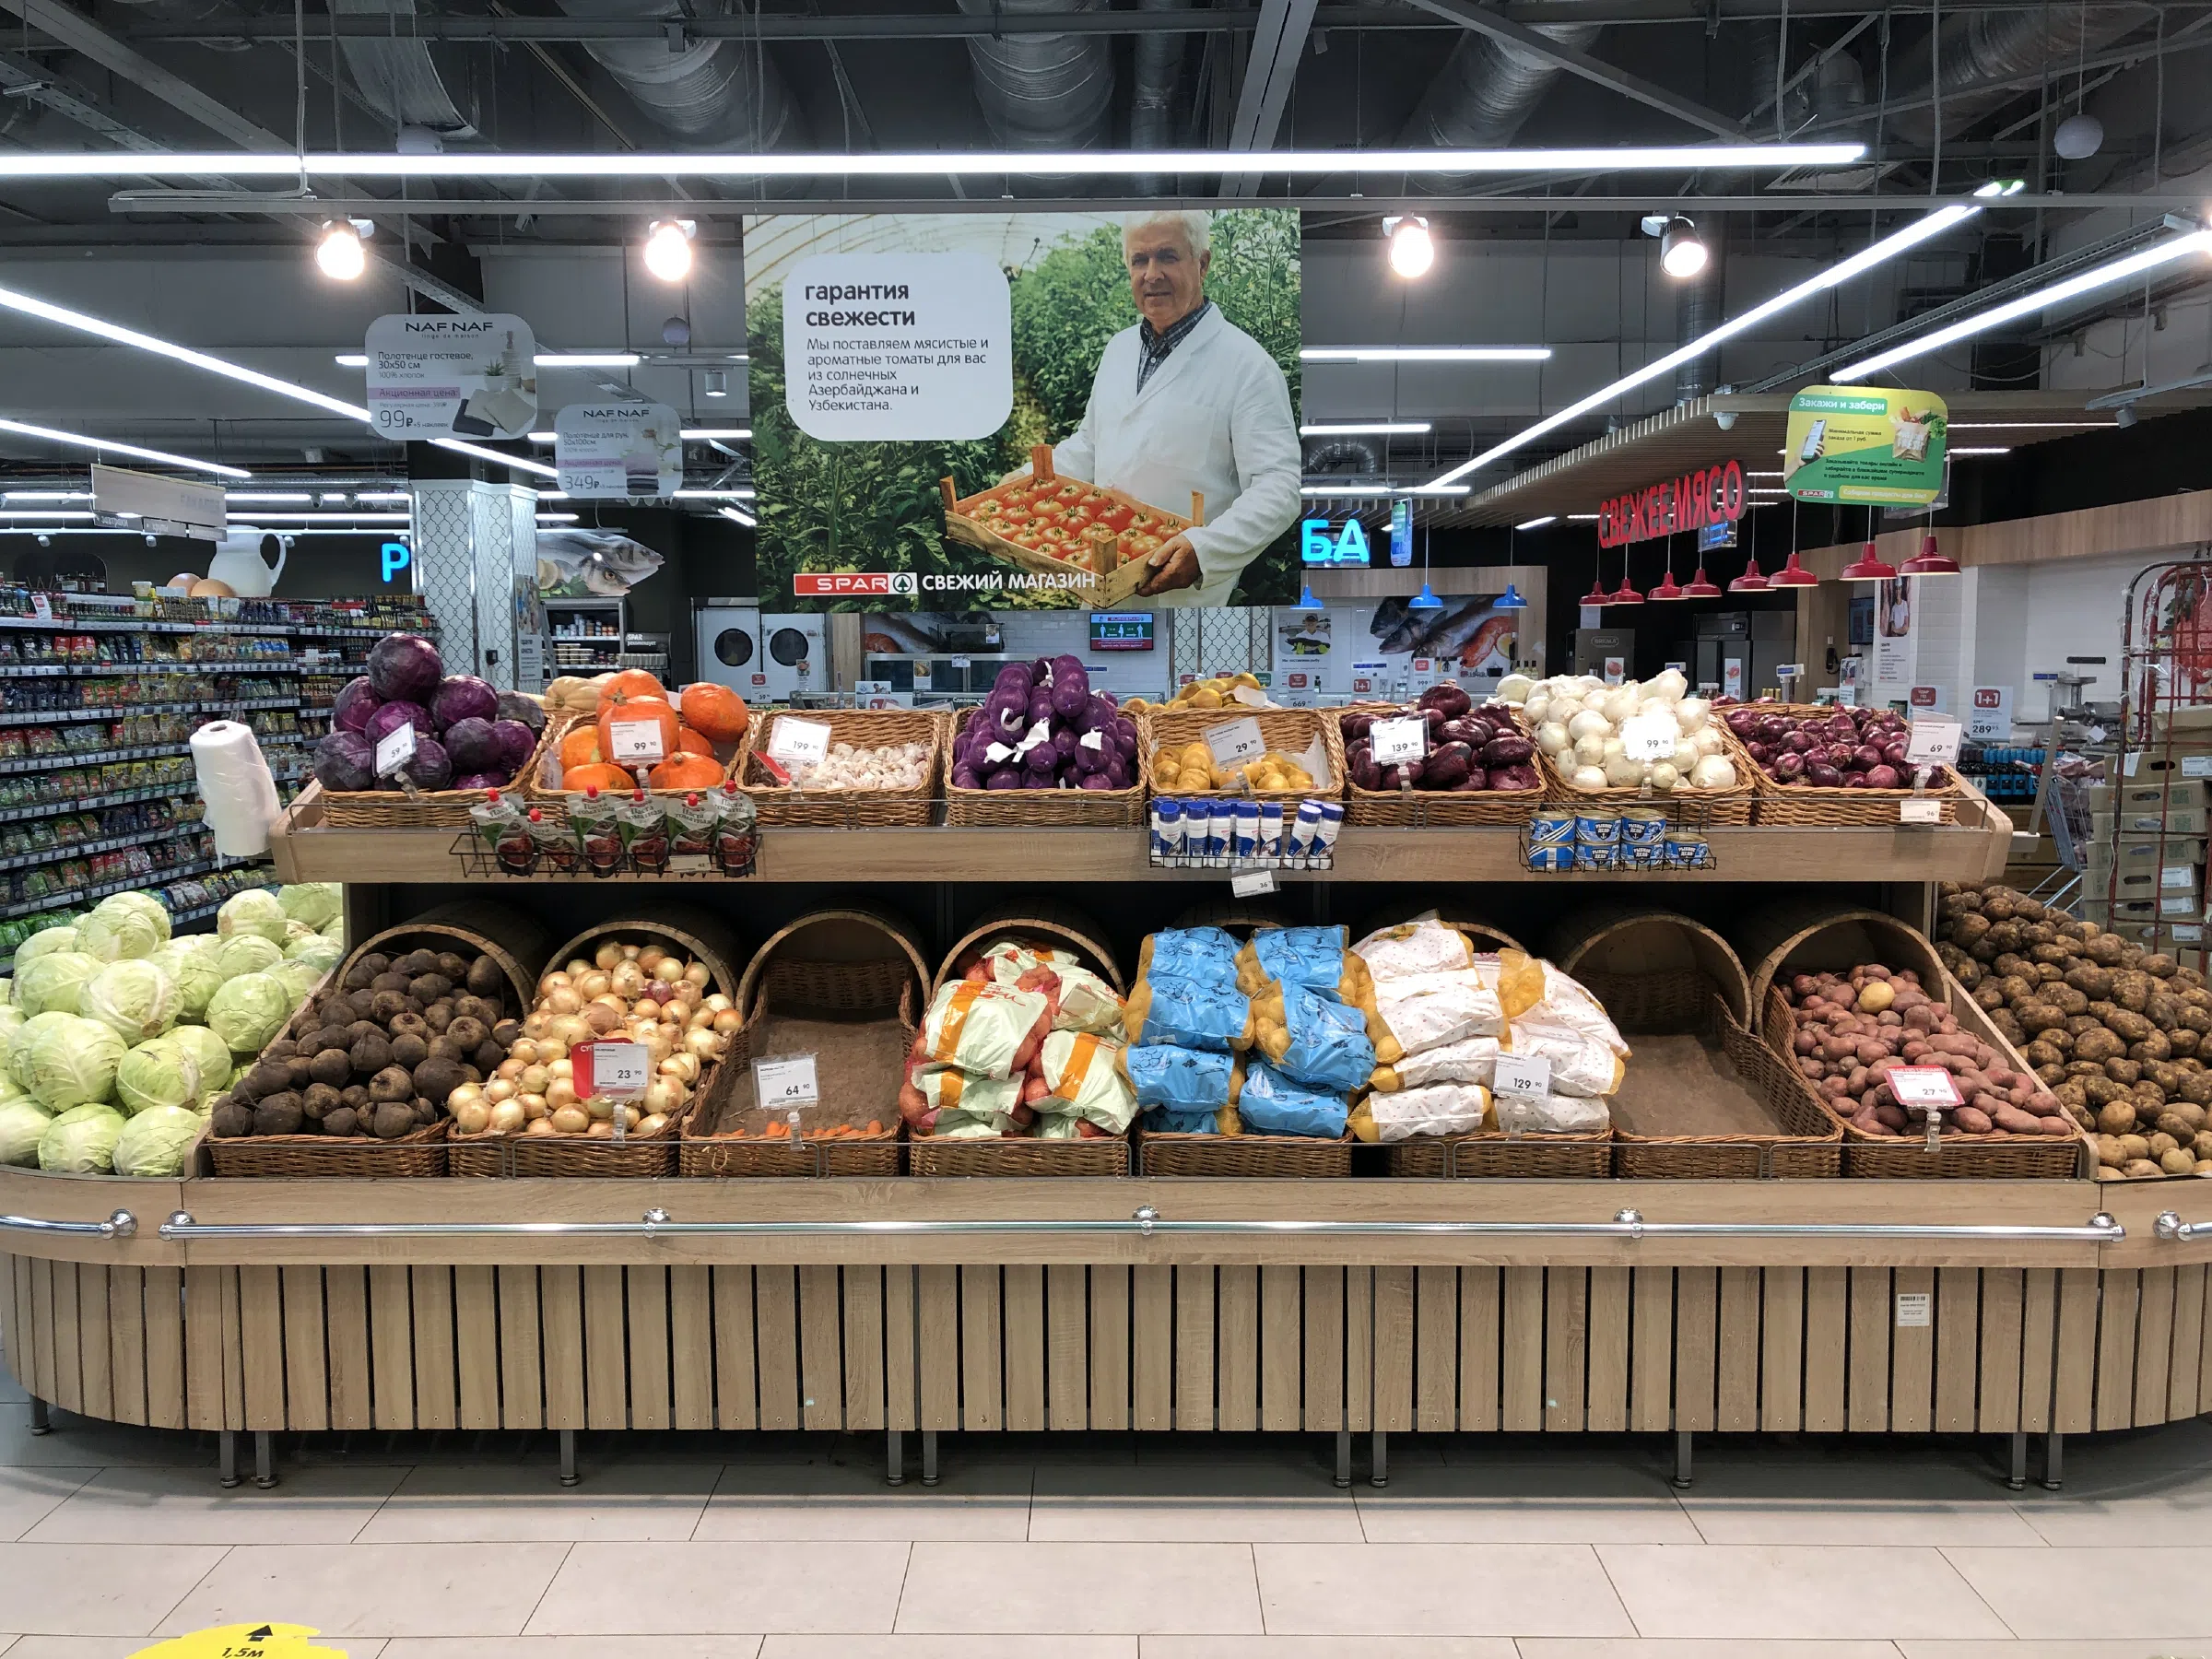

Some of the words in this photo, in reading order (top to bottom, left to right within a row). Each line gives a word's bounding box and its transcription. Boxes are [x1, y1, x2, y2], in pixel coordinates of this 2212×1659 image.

[805, 284, 910, 305] гарантия
[806, 311, 915, 326] свежести
[406, 322, 448, 332] NAF
[452, 322, 494, 332] NAF
[806, 338, 830, 350] Мы
[832, 339, 911, 350] поставляем
[913, 338, 977, 349] мясистые
[981, 338, 989, 348] и
[378, 351, 429, 360] Полотенце
[429, 352, 474, 360] гостевое,
[807, 355, 882, 369] ароматные
[885, 354, 934, 365] томаты
[936, 354, 960, 367] для
[964, 353, 986, 364] вас
[808, 371, 823, 381] из
[826, 370, 898, 381] солнечных
[379, 388, 433, 397] Акционная
[433, 389, 458, 398] цена:
[808, 383, 908, 398] Азербайджана
[911, 384, 919, 394] и
[808, 399, 893, 411] Узбекистана.
[1799, 397, 1838, 408] Закажи
[1840, 401, 1846, 409] и
[1849, 400, 1885, 412] забери
[583, 409, 615, 418] NAF
[618, 409, 650, 418] NAF
[1598, 482, 1669, 548] СВЕЖЕЕ
[1673, 459, 1743, 532] МЯСО
[817, 577, 888, 591] SPAR
[922, 570, 1003, 591] СВЕЖИЙ
[1007, 571, 1096, 590] МАГАЗИН
[1354, 680, 1371, 690] 1+1
[1976, 691, 1999, 705] 1+1
[1972, 724, 1992, 734] 289
[634, 742, 647, 750] 99
[794, 740, 809, 750] 199
[1235, 743, 1248, 753] 29
[1392, 743, 1408, 752] 139
[1646, 739, 1659, 748] 99
[1930, 744, 1943, 753] 69
[391, 747, 400, 758] 59
[583, 802, 607, 810] Паста
[721, 798, 743, 807] Паста
[630, 805, 654, 815] Паста
[682, 807, 704, 818] Паста
[617, 1069, 630, 1079] 23
[1513, 1077, 1532, 1089] 129
[785, 1085, 799, 1096] 64
